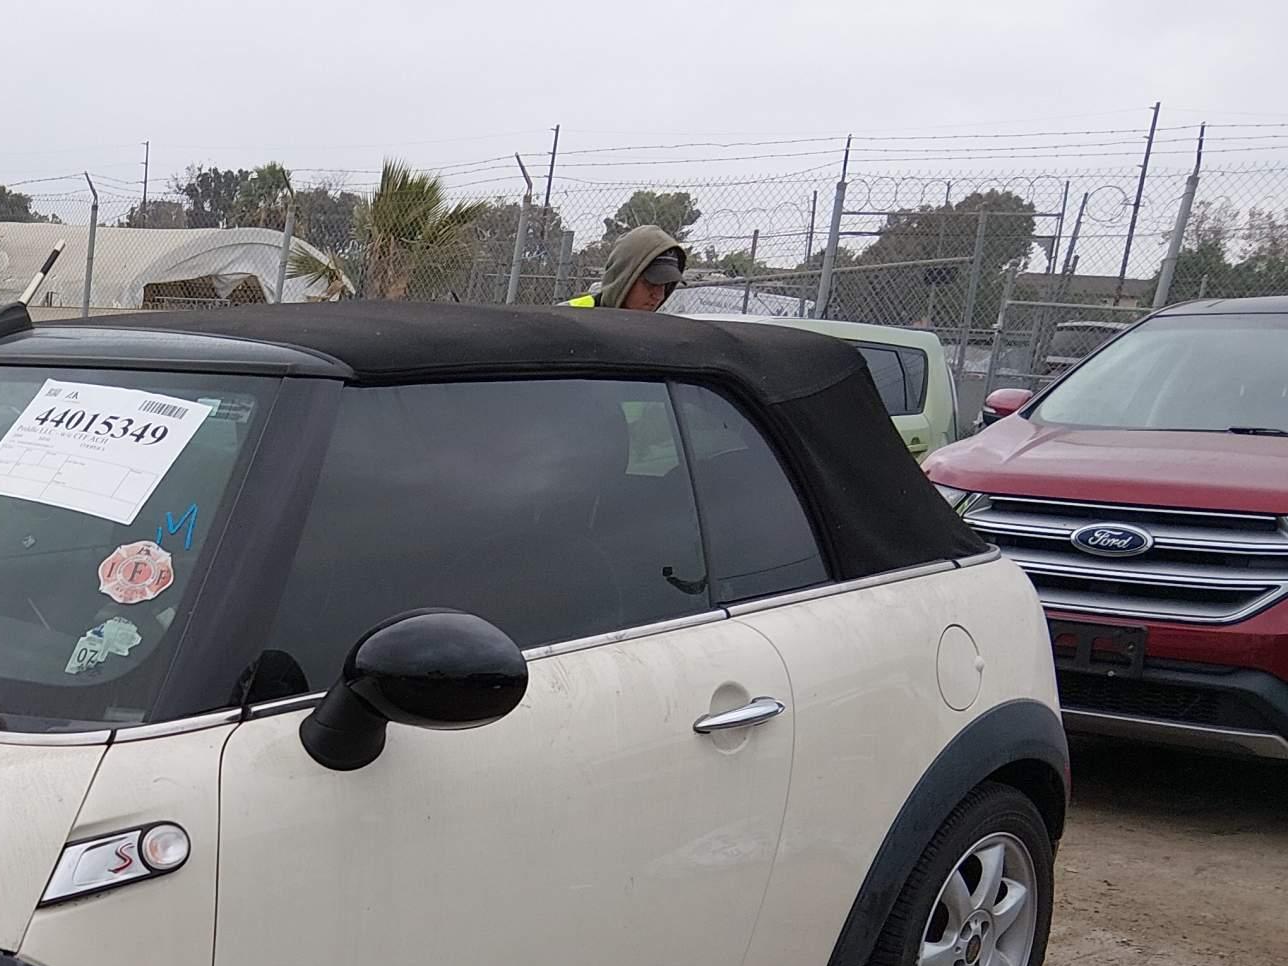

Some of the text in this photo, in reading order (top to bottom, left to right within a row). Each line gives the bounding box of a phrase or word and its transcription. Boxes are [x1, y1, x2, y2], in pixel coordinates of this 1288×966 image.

[34, 406, 169, 446] 44015349
[1088, 529, 1133, 549] Ford
[108, 842, 136, 874] S
